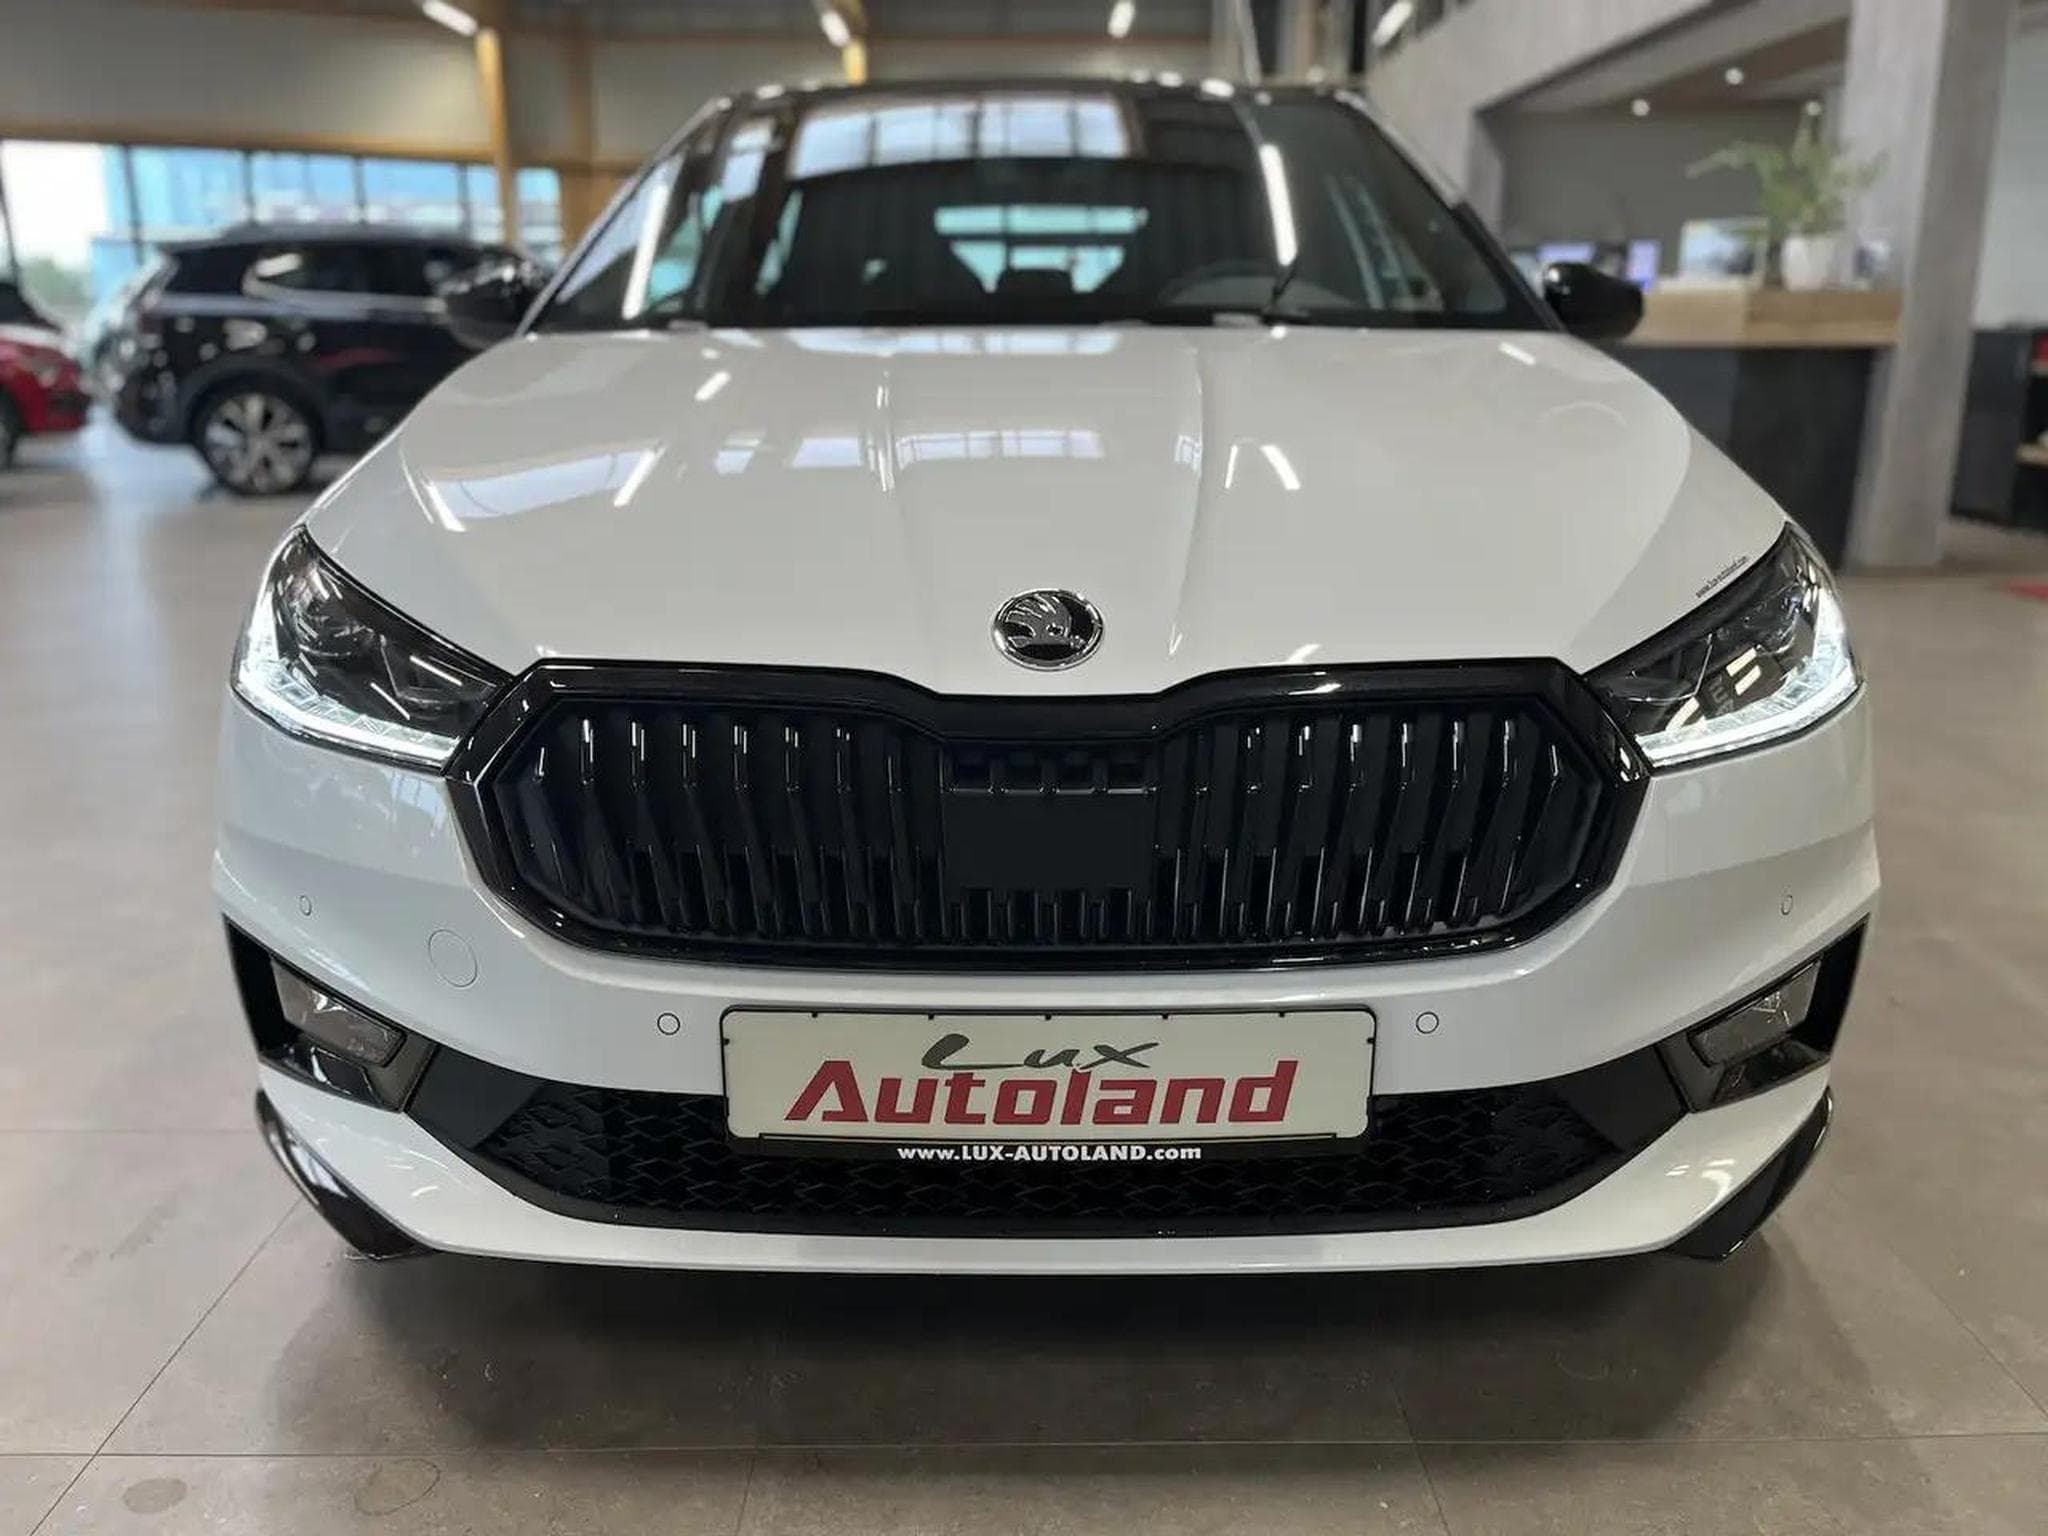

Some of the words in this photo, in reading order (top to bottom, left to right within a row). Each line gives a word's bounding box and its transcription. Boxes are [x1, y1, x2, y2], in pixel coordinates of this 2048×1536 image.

[921, 1033, 1160, 1071] Lux
[784, 1059, 1299, 1126] Autoland
[897, 1144, 1202, 1162] www.LUX-AUTOLAND.com
